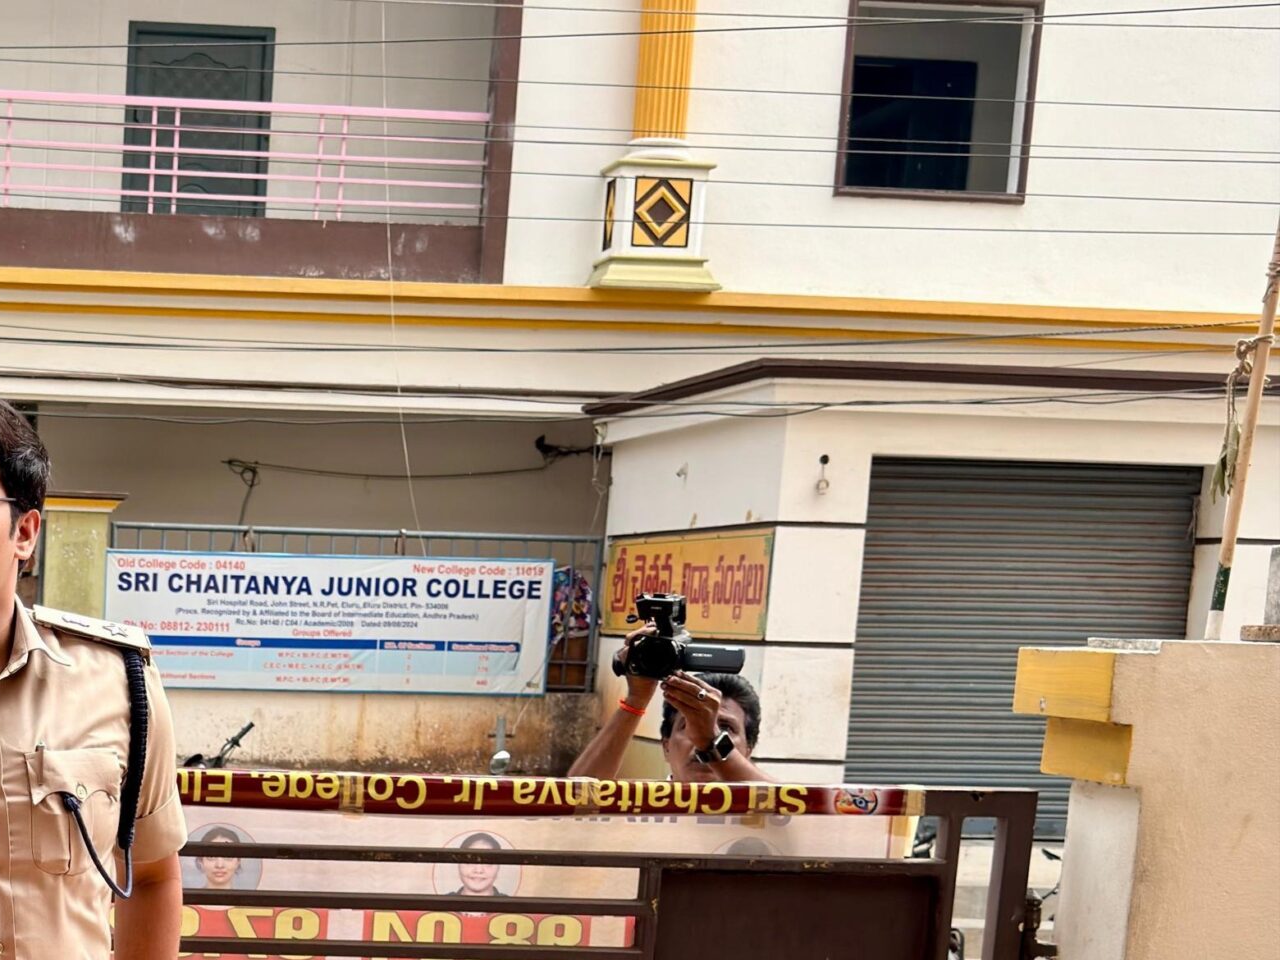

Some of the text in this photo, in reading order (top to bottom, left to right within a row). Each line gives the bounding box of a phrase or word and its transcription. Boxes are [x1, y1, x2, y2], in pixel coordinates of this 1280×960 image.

[117, 558, 135, 569] Old
[138, 558, 177, 571] College
[180, 560, 206, 570] Code
[215, 560, 246, 570] 04140
[413, 564, 434, 574] New
[436, 564, 476, 578] College
[481, 566, 506, 576] Code
[117, 572, 543, 599] SRI CHAITANYA JUNIOR COLLEGE
[196, 621, 230, 632] 230111
[443, 776, 499, 811] Jr.
[513, 777, 733, 815] Chaitanya
[748, 783, 808, 816] Sri
